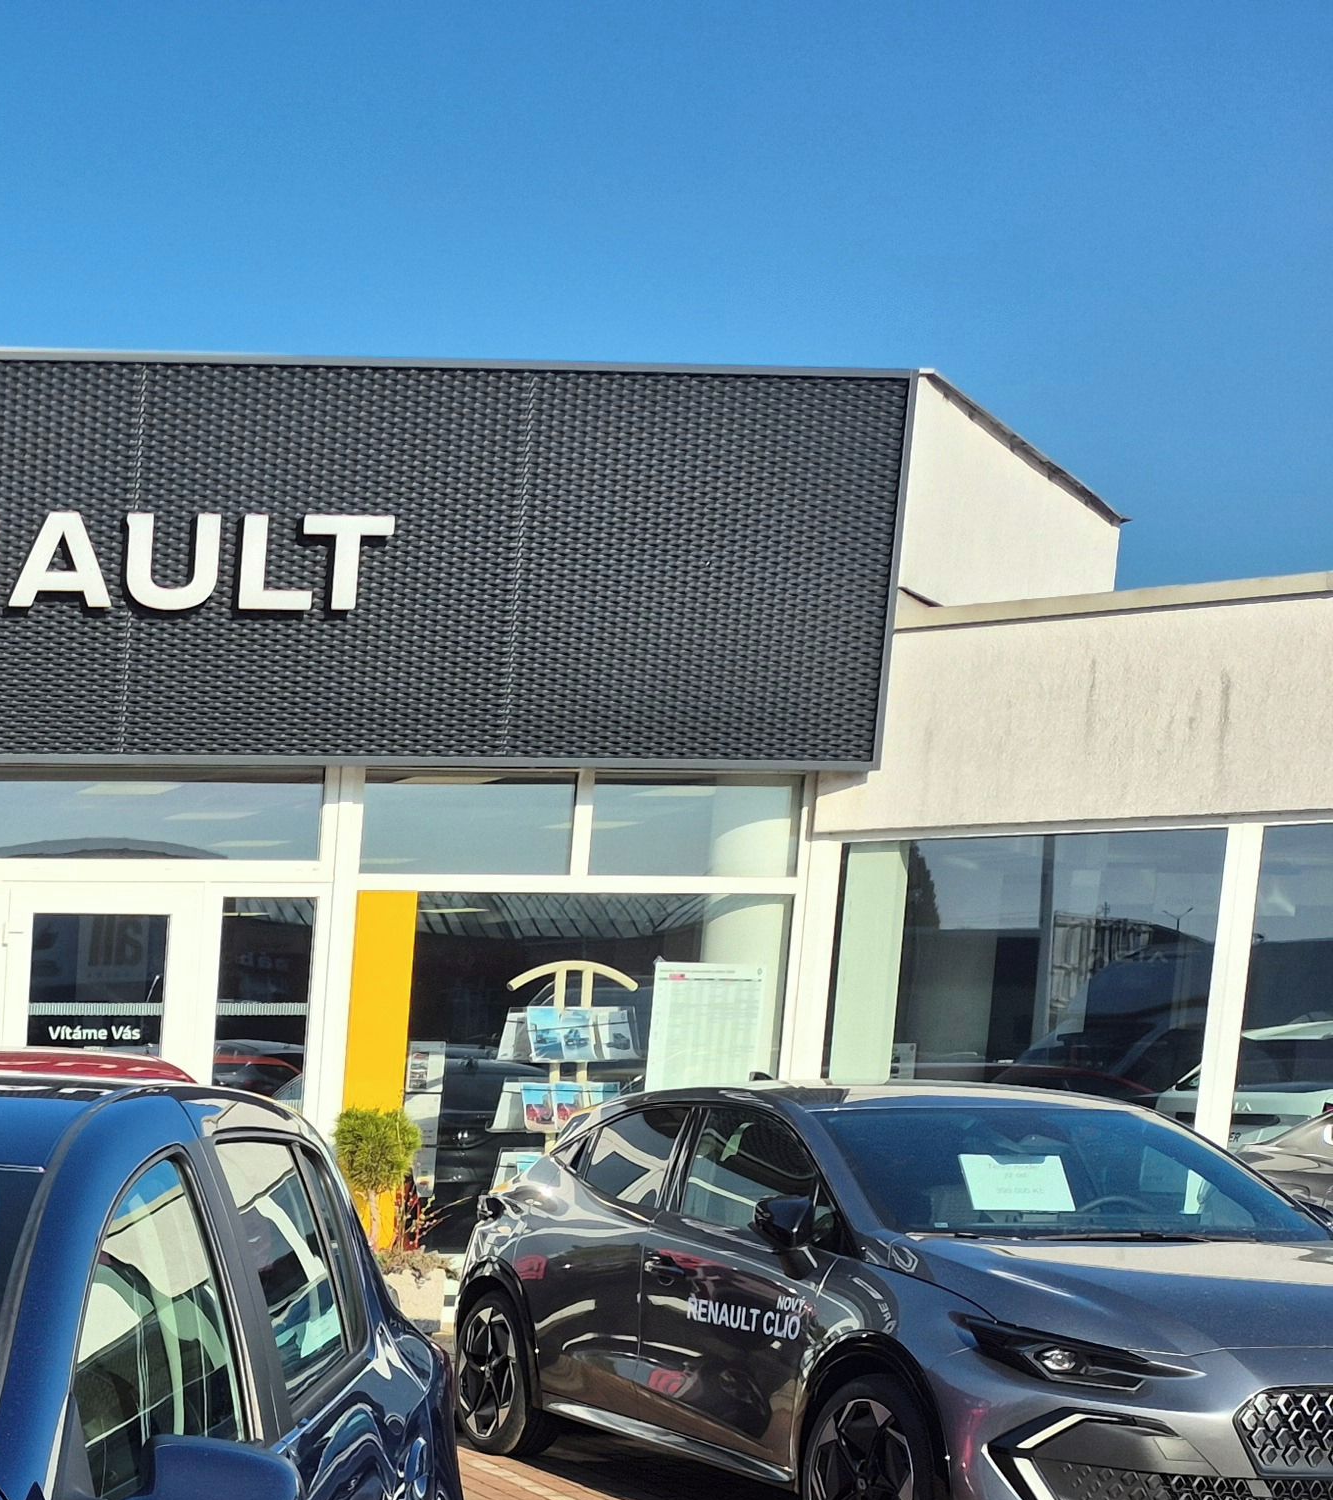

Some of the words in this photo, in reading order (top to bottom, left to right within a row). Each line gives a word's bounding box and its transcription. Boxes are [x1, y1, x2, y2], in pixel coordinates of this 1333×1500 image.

[48, 1025, 108, 1040] Vítáme
[110, 1025, 141, 1040] Vás
[686, 1296, 761, 1332] RENAULT
[762, 1311, 801, 1340] CLIO
